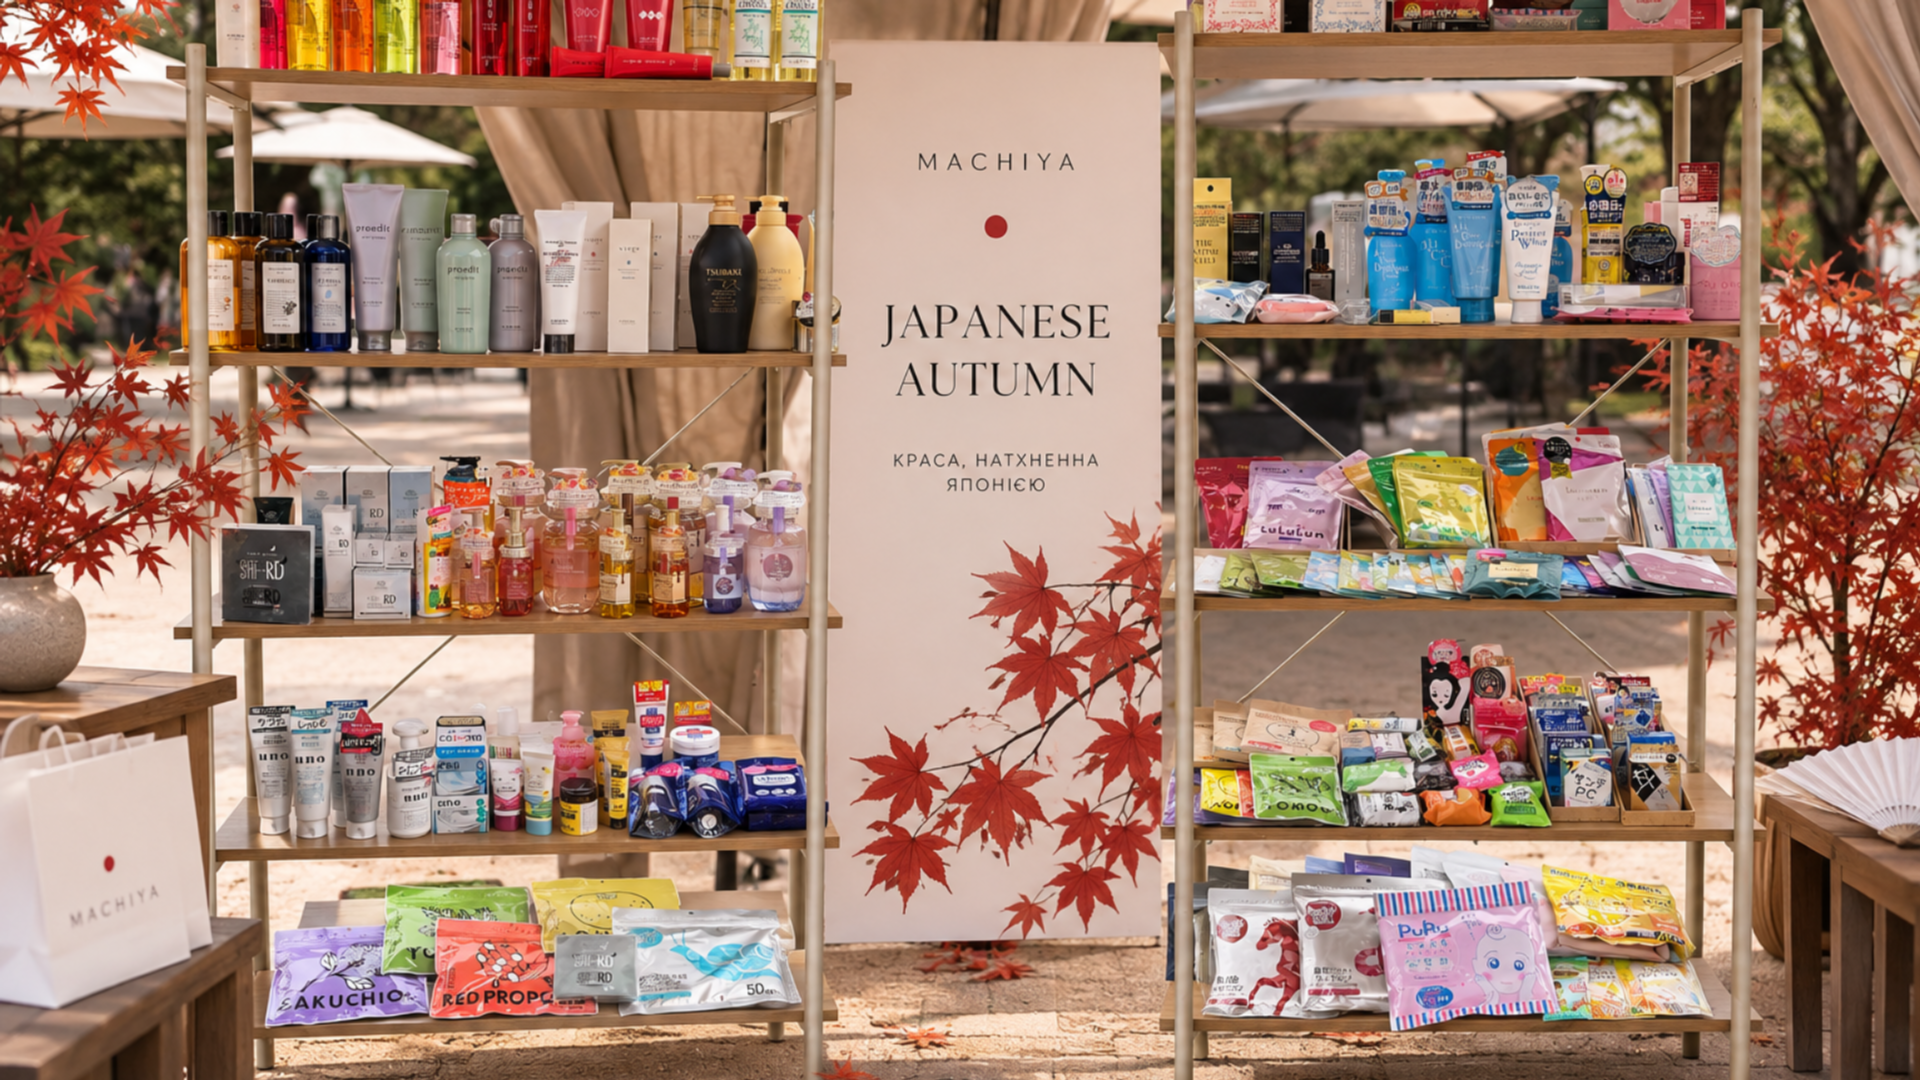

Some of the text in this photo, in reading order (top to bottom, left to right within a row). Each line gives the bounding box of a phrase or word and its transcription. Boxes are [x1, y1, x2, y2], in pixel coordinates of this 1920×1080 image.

[918, 152, 1075, 171] MACHIYA
[881, 304, 1111, 348] JAPANESE
[896, 361, 1096, 397] AUTUMN
[893, 453, 1100, 470] КРАСА, НАТХНЕННА
[946, 477, 1046, 493] ЯПОНІЄЮ
[258, 751, 289, 762] uno
[294, 754, 326, 765] uno
[69, 884, 160, 930] MACHIYA
[746, 982, 765, 997] 50
[442, 991, 480, 1007] RED
